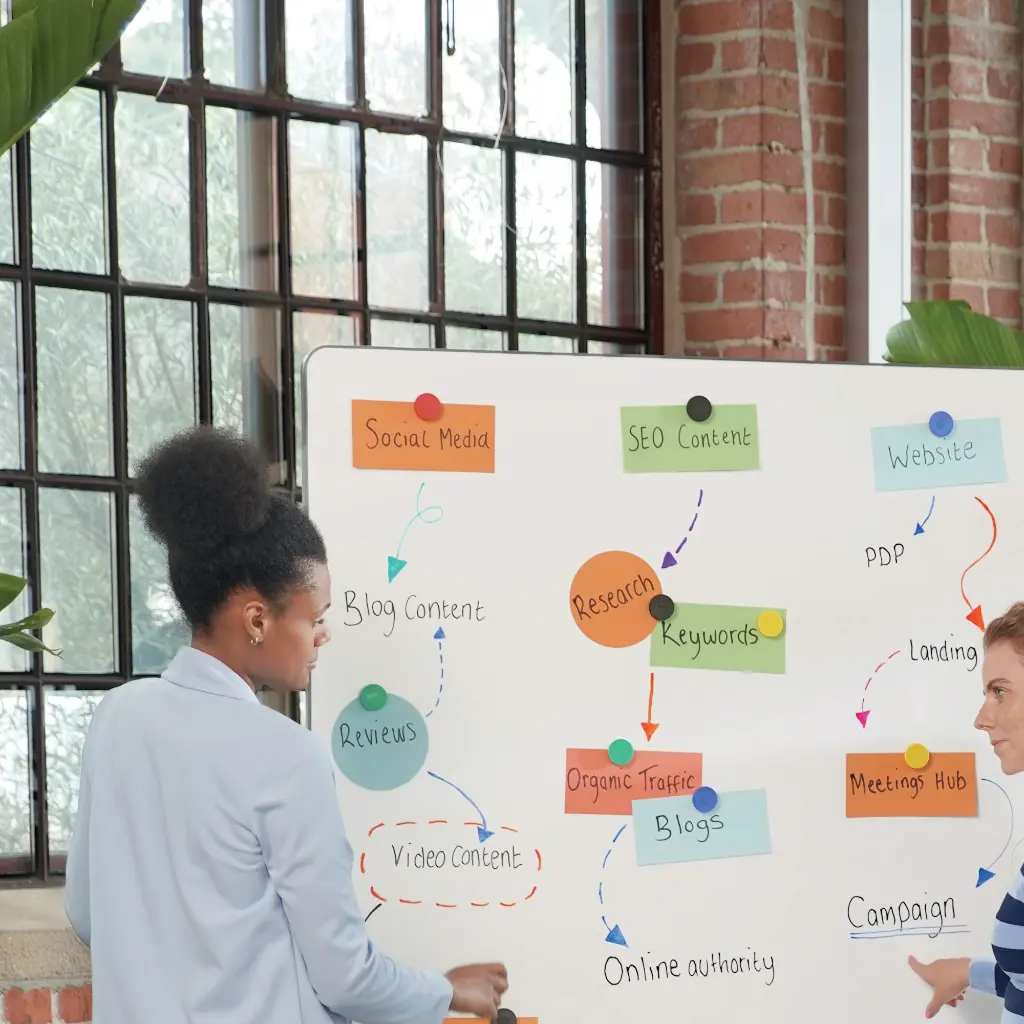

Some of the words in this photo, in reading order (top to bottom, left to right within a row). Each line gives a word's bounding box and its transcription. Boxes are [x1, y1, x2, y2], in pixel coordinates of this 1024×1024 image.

[365, 418, 430, 449] Social
[440, 424, 490, 450] Media
[628, 425, 664, 452] SEO
[678, 424, 752, 449] Content
[888, 436, 977, 469] Website
[865, 542, 905, 567] PDP
[343, 590, 396, 638] Blog
[404, 595, 486, 621] Content
[572, 574, 655, 621] Research
[661, 620, 759, 660] Keywords
[909, 634, 978, 672] Landing
[340, 719, 417, 749] Reviews
[567, 767, 633, 804] Organic
[638, 764, 696, 792] Traffic
[849, 769, 924, 799] Meetings
[935, 773, 967, 791] Hub
[655, 813, 724, 842] Blogs
[391, 844, 446, 869] Video
[451, 844, 523, 870] Content
[847, 891, 956, 938] Campaign
[604, 950, 681, 986] Online
[688, 946, 775, 986] authority
